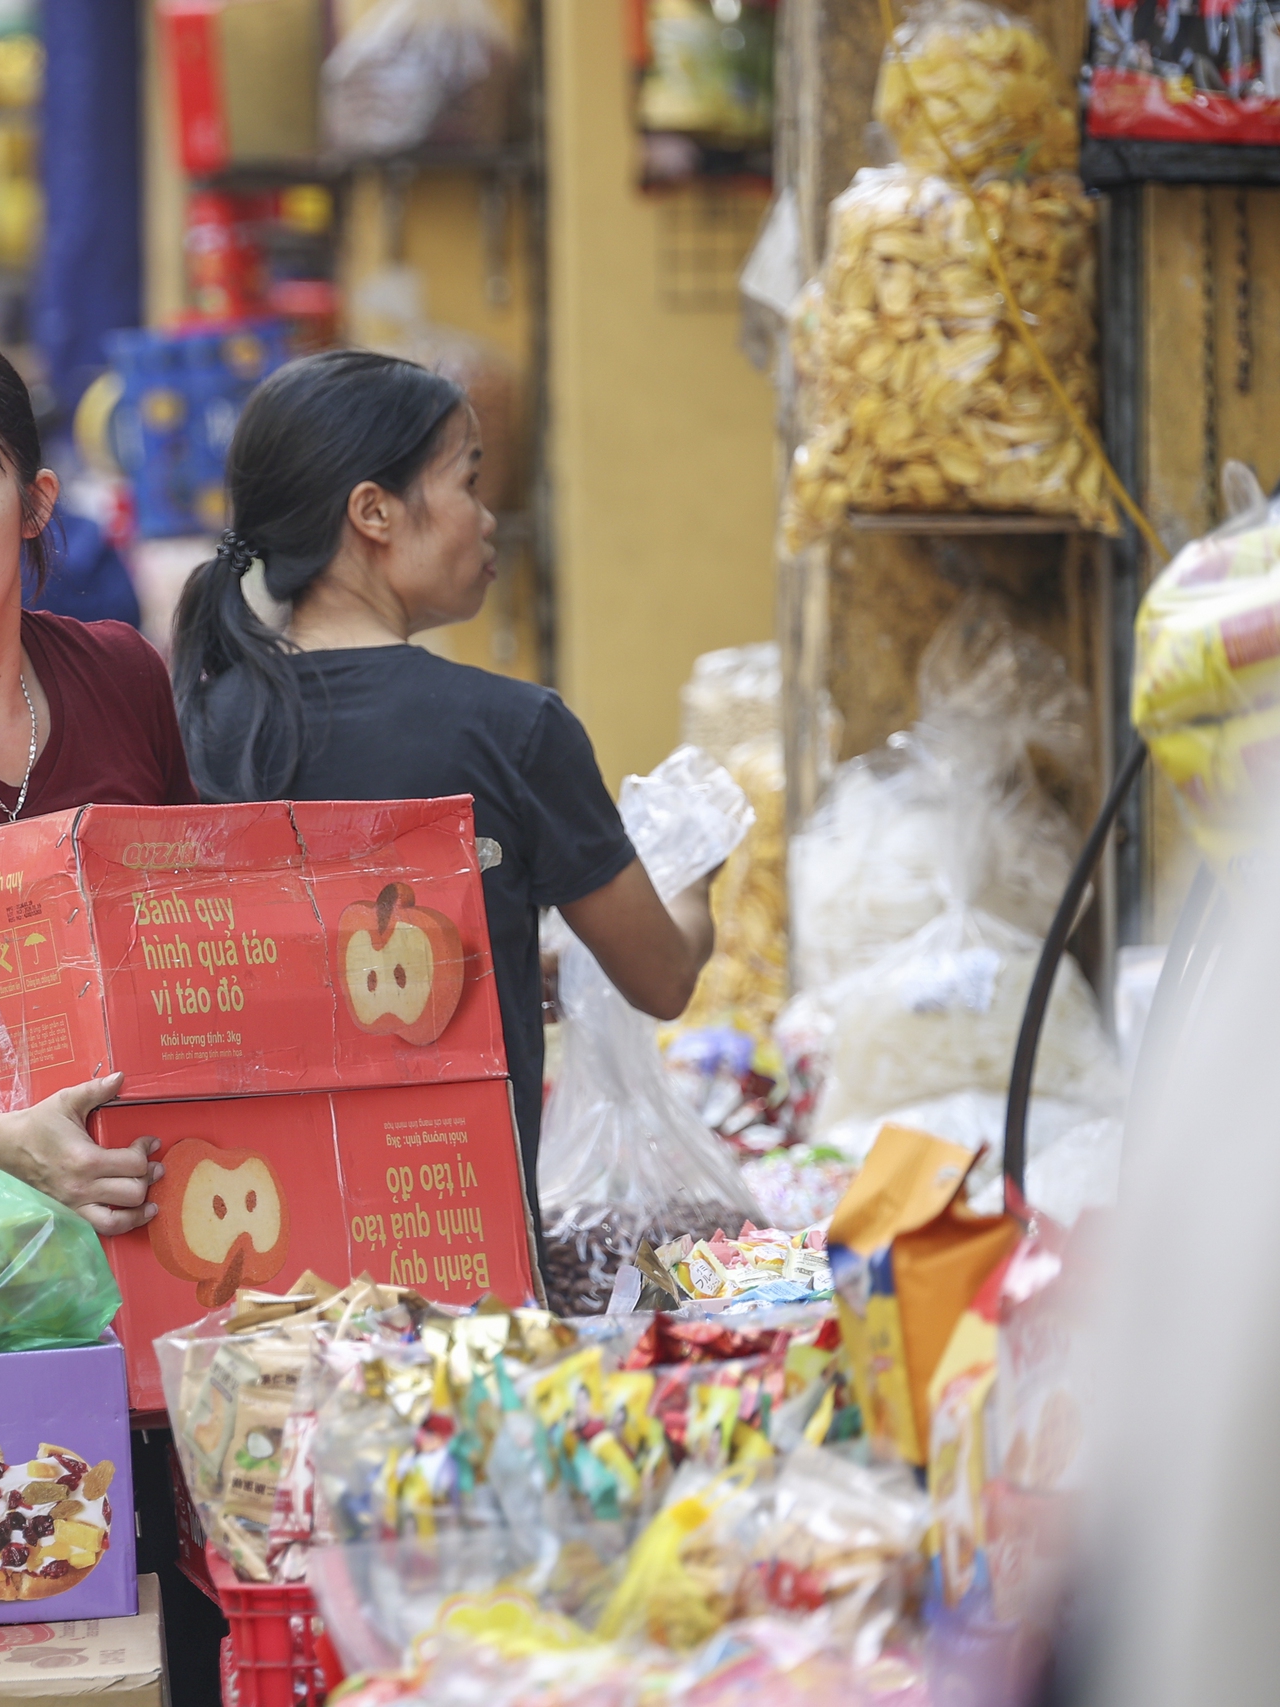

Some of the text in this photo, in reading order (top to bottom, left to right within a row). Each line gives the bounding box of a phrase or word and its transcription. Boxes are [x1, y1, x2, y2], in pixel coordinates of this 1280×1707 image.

[6, 870, 24, 895] quy
[131, 890, 235, 931] Bánh quy
[141, 929, 277, 975] hình quả táo
[150, 975, 245, 1024] vị táo đỏ
[160, 1030, 242, 1047] Khối lượng tịnh: 3kg
[385, 1130, 468, 1149] Khối lượng tịnh: 3kg
[385, 1153, 478, 1204] vị táo đỏ
[351, 1202, 484, 1252] hình quả táo
[390, 1249, 490, 1291] Bánh quy
